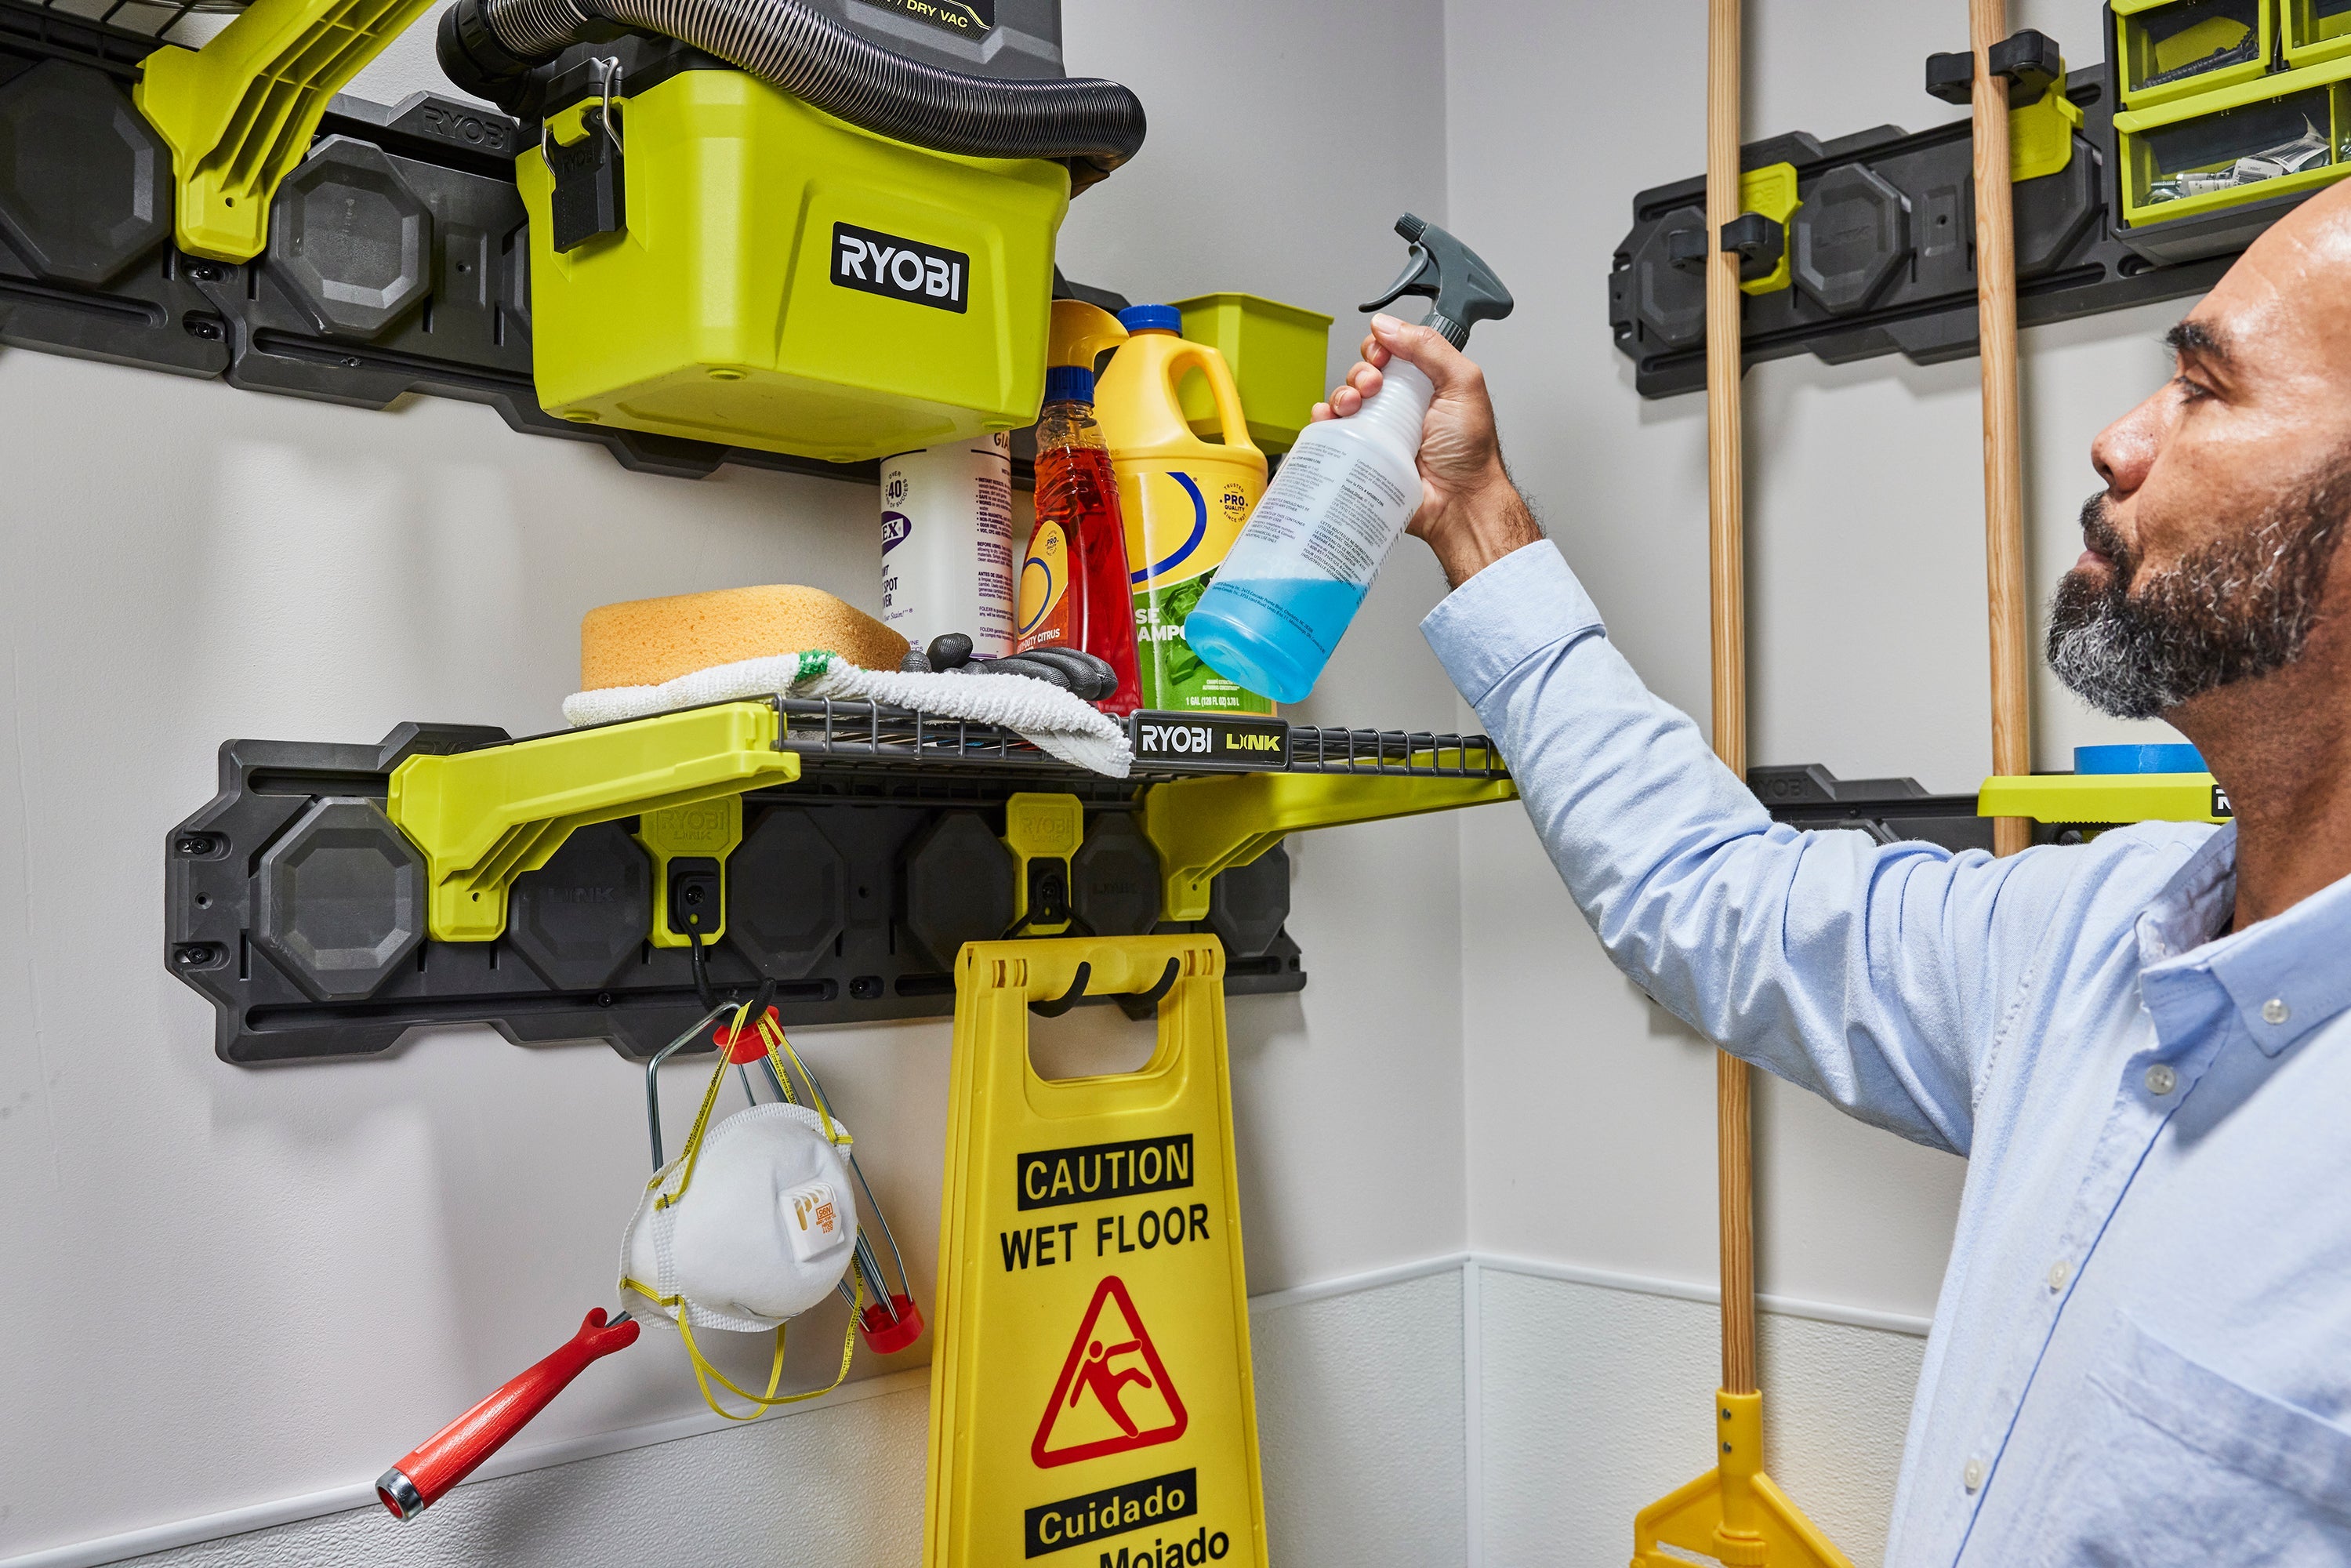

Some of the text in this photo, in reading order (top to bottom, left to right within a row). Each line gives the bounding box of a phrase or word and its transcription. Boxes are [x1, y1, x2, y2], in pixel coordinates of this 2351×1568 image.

[906, 0, 937, 16] DRY
[940, 9, 968, 28] VAC
[423, 105, 510, 152] RYOBI
[840, 234, 960, 301] RYOBI
[994, 433, 1010, 450] GIA
[888, 480, 902, 499] 40
[1224, 483, 1244, 493] TRUSTED
[1224, 494, 1245, 506] PRO
[1224, 511, 1237, 523] SINCE
[1319, 519, 1331, 529] CETTE
[1331, 525, 1350, 541] BOUTEILLE
[1319, 531, 1337, 546] CONTENU
[1047, 537, 1057, 546] PRO
[1333, 533, 1344, 543] AVEC
[1342, 540, 1352, 549] TOUT
[1300, 550, 1326, 571] INDUSTRIELLE
[1302, 546, 1314, 557] POUR
[1313, 553, 1336, 572] UTILISATION
[1136, 608, 1160, 624] SE
[1037, 628, 1061, 642] CITRUS
[1186, 697, 1190, 706] 1
[1191, 697, 1200, 706] GAL
[1201, 697, 1212, 707] (128
[1213, 697, 1218, 706] FL
[1218, 697, 1227, 707] OZ)
[1236, 697, 1239, 706] L
[1141, 725, 1281, 753] RYOBI LINK
[660, 810, 724, 830] RYOBI
[1023, 816, 1069, 833] RYOBI
[674, 832, 712, 840] LINK
[1025, 1142, 1188, 1200] CAUTION
[818, 1206, 832, 1218] N95
[1000, 1203, 1210, 1272] WET FLOOR
[852, 1252, 862, 1279] WARNIN
[1039, 1485, 1185, 1544] Cuidado
